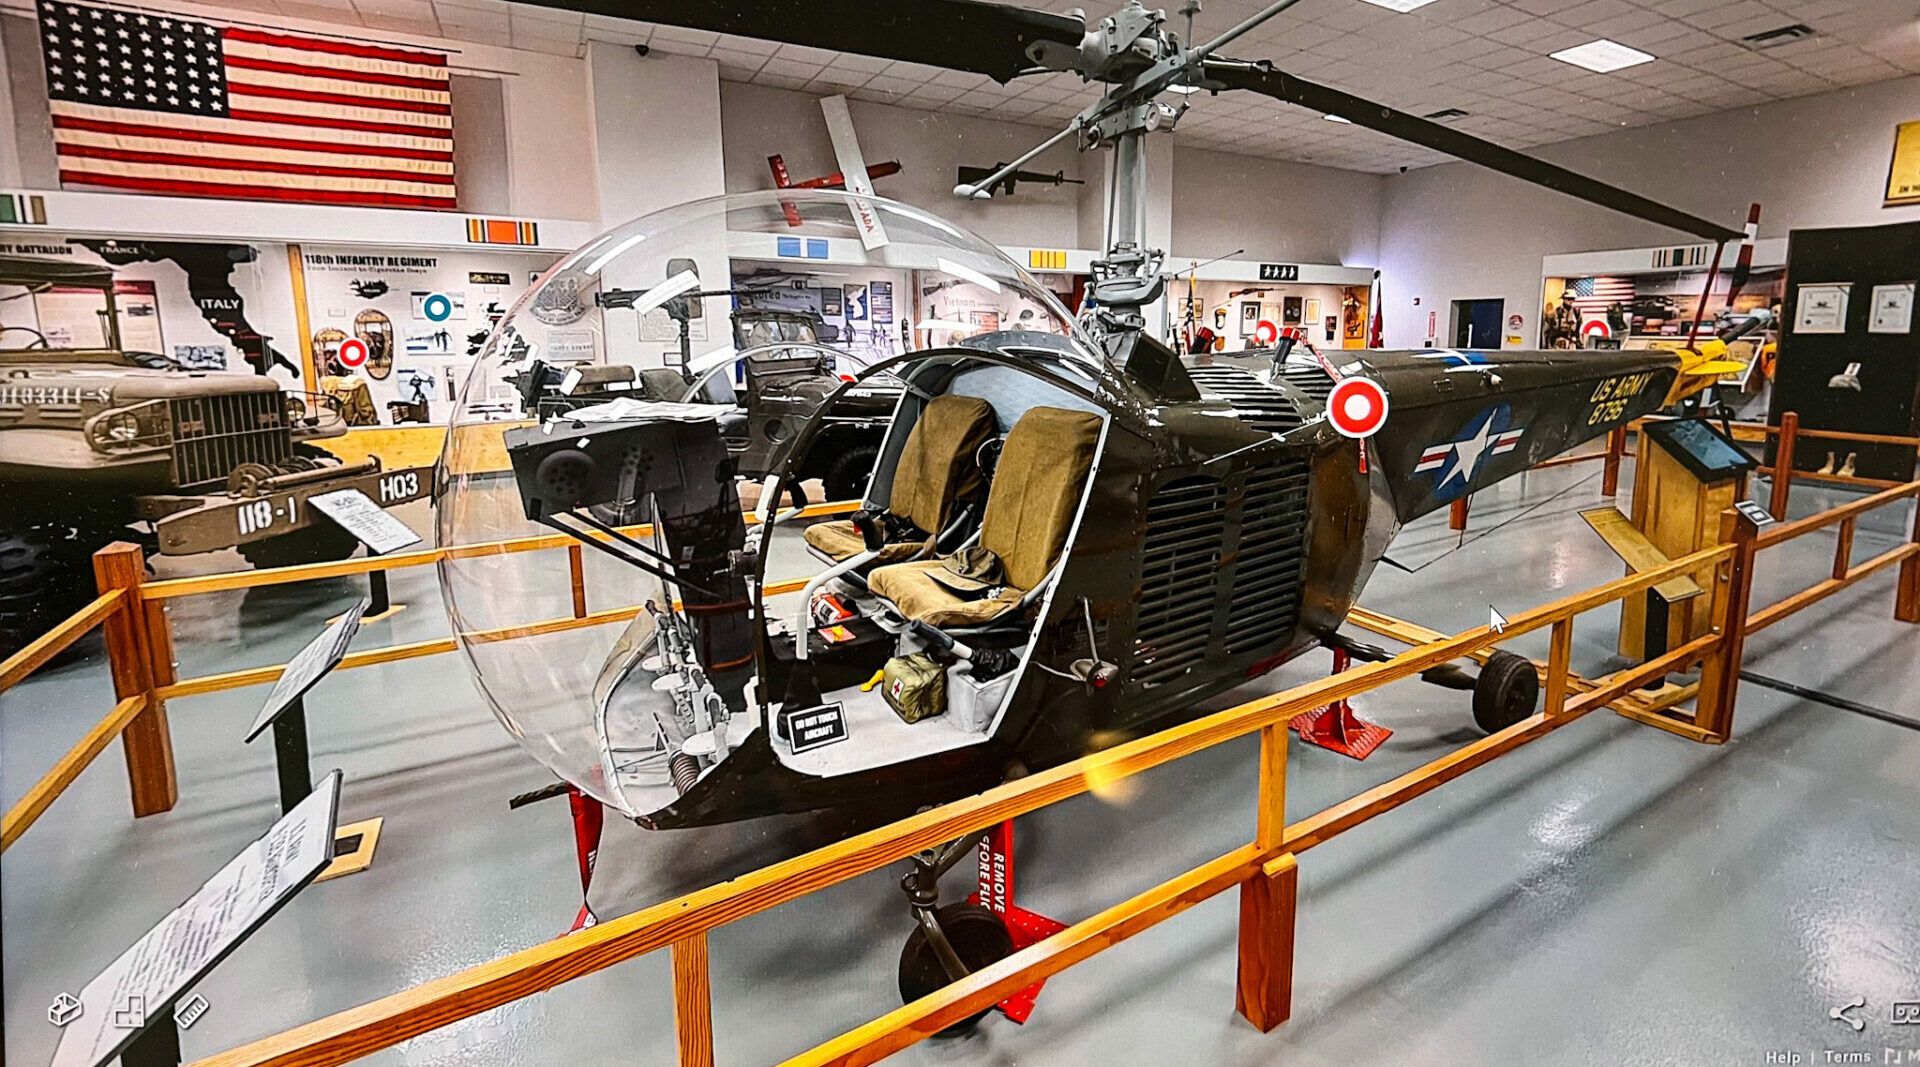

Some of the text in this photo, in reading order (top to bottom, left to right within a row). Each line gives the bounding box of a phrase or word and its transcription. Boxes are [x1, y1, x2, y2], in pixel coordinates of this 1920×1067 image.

[16, 245, 73, 255] BATTALION
[99, 246, 139, 255] FRANCE
[304, 254, 437, 268] 118th INFANTRY REGIMENT
[200, 298, 240, 310] ITALY
[1589, 371, 1655, 403] US ARMY
[994, 852, 1005, 913] REMOVE
